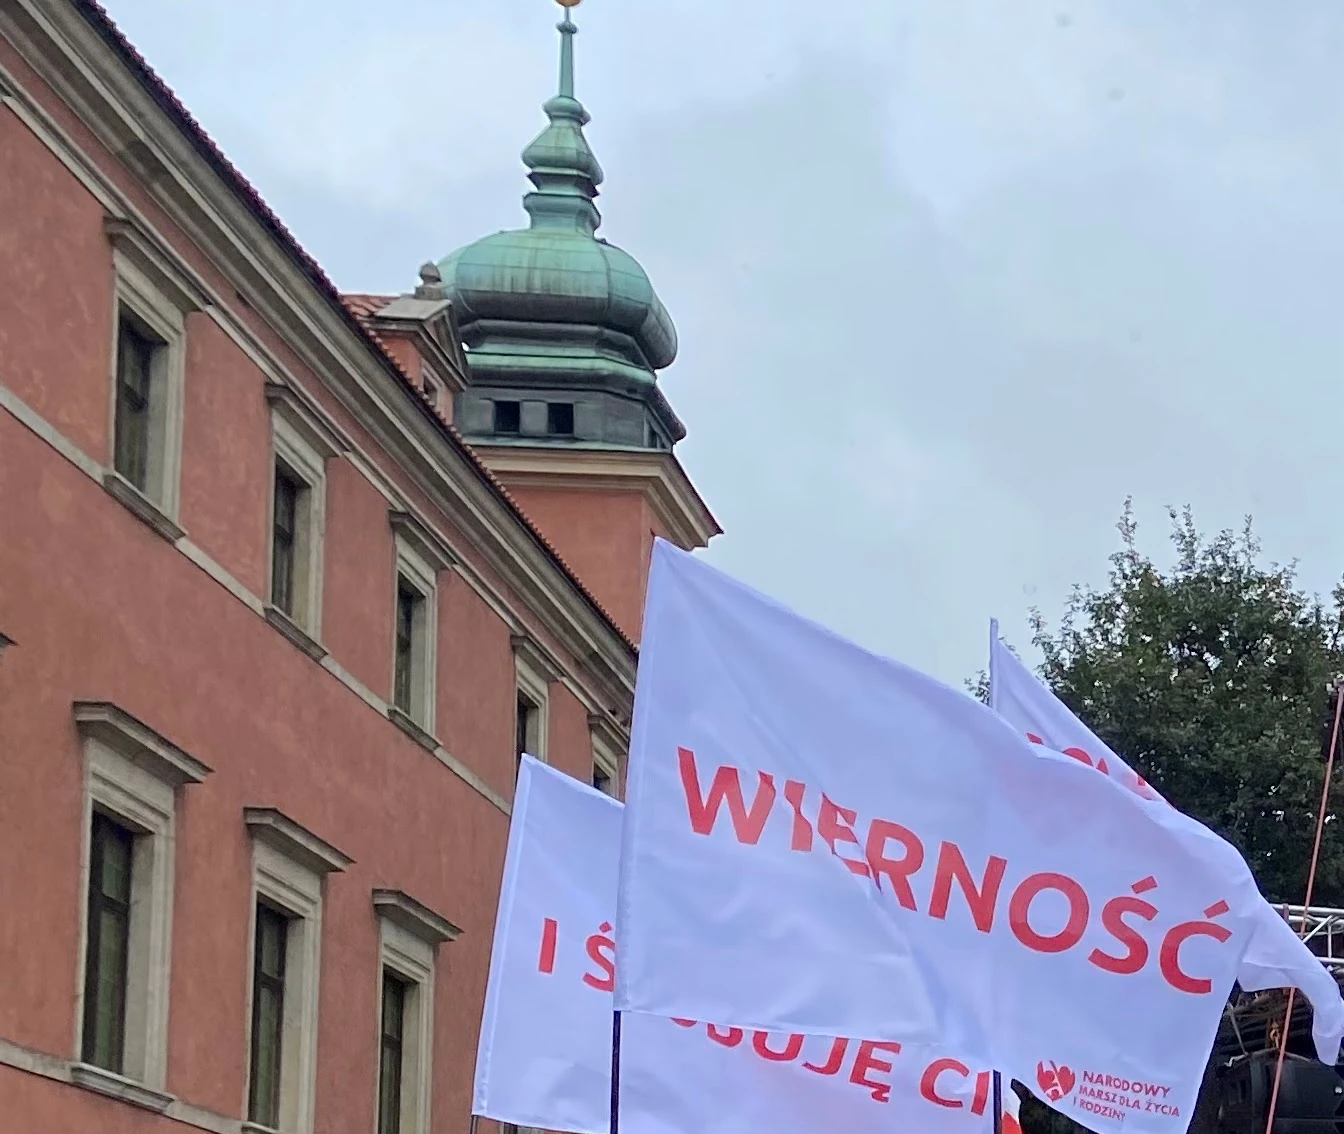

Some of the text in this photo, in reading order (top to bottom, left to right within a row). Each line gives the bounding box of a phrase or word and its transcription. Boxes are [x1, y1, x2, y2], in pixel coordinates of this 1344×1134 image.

[677, 746, 1234, 995] WIERNOŚĆ
[538, 917, 558, 974] I
[919, 1058, 991, 1117] CI
[1079, 1084, 1181, 1118] MARSZ DLA ŻYCIA
[1082, 1070, 1172, 1099] NARODOWY
[1073, 1096, 1126, 1123] I RODZINY
